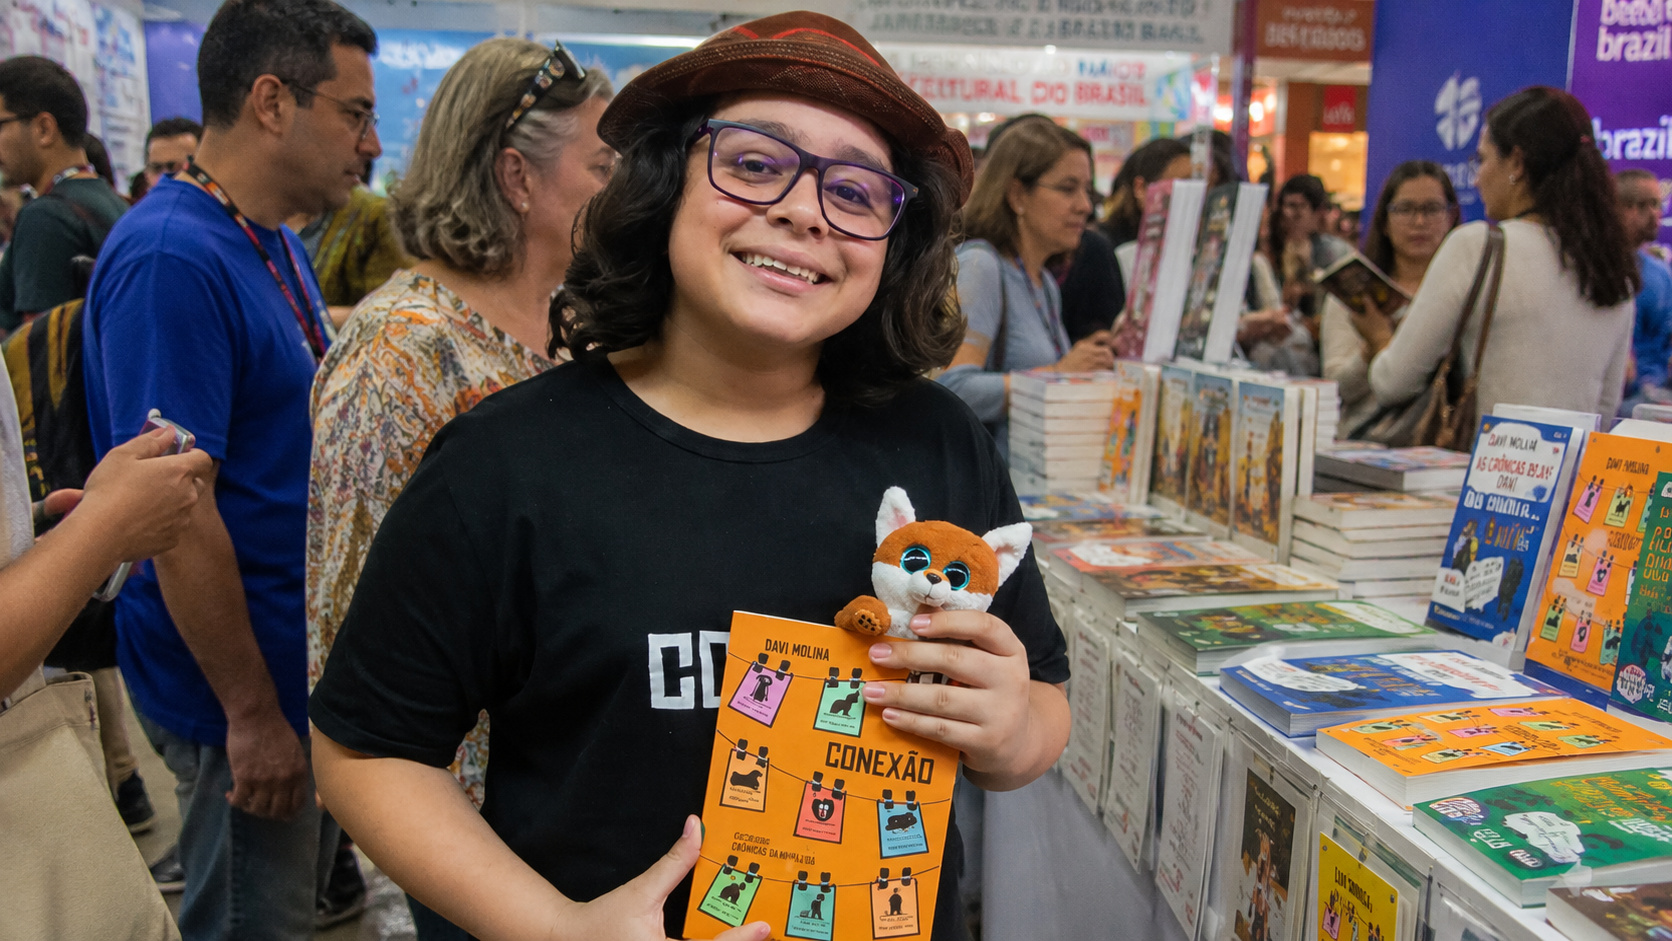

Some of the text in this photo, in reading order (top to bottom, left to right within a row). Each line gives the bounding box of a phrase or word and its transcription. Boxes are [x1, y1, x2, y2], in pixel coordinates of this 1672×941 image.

[764, 638, 830, 662] DAVI MOLINA
[825, 741, 935, 785] CONEXÃO
